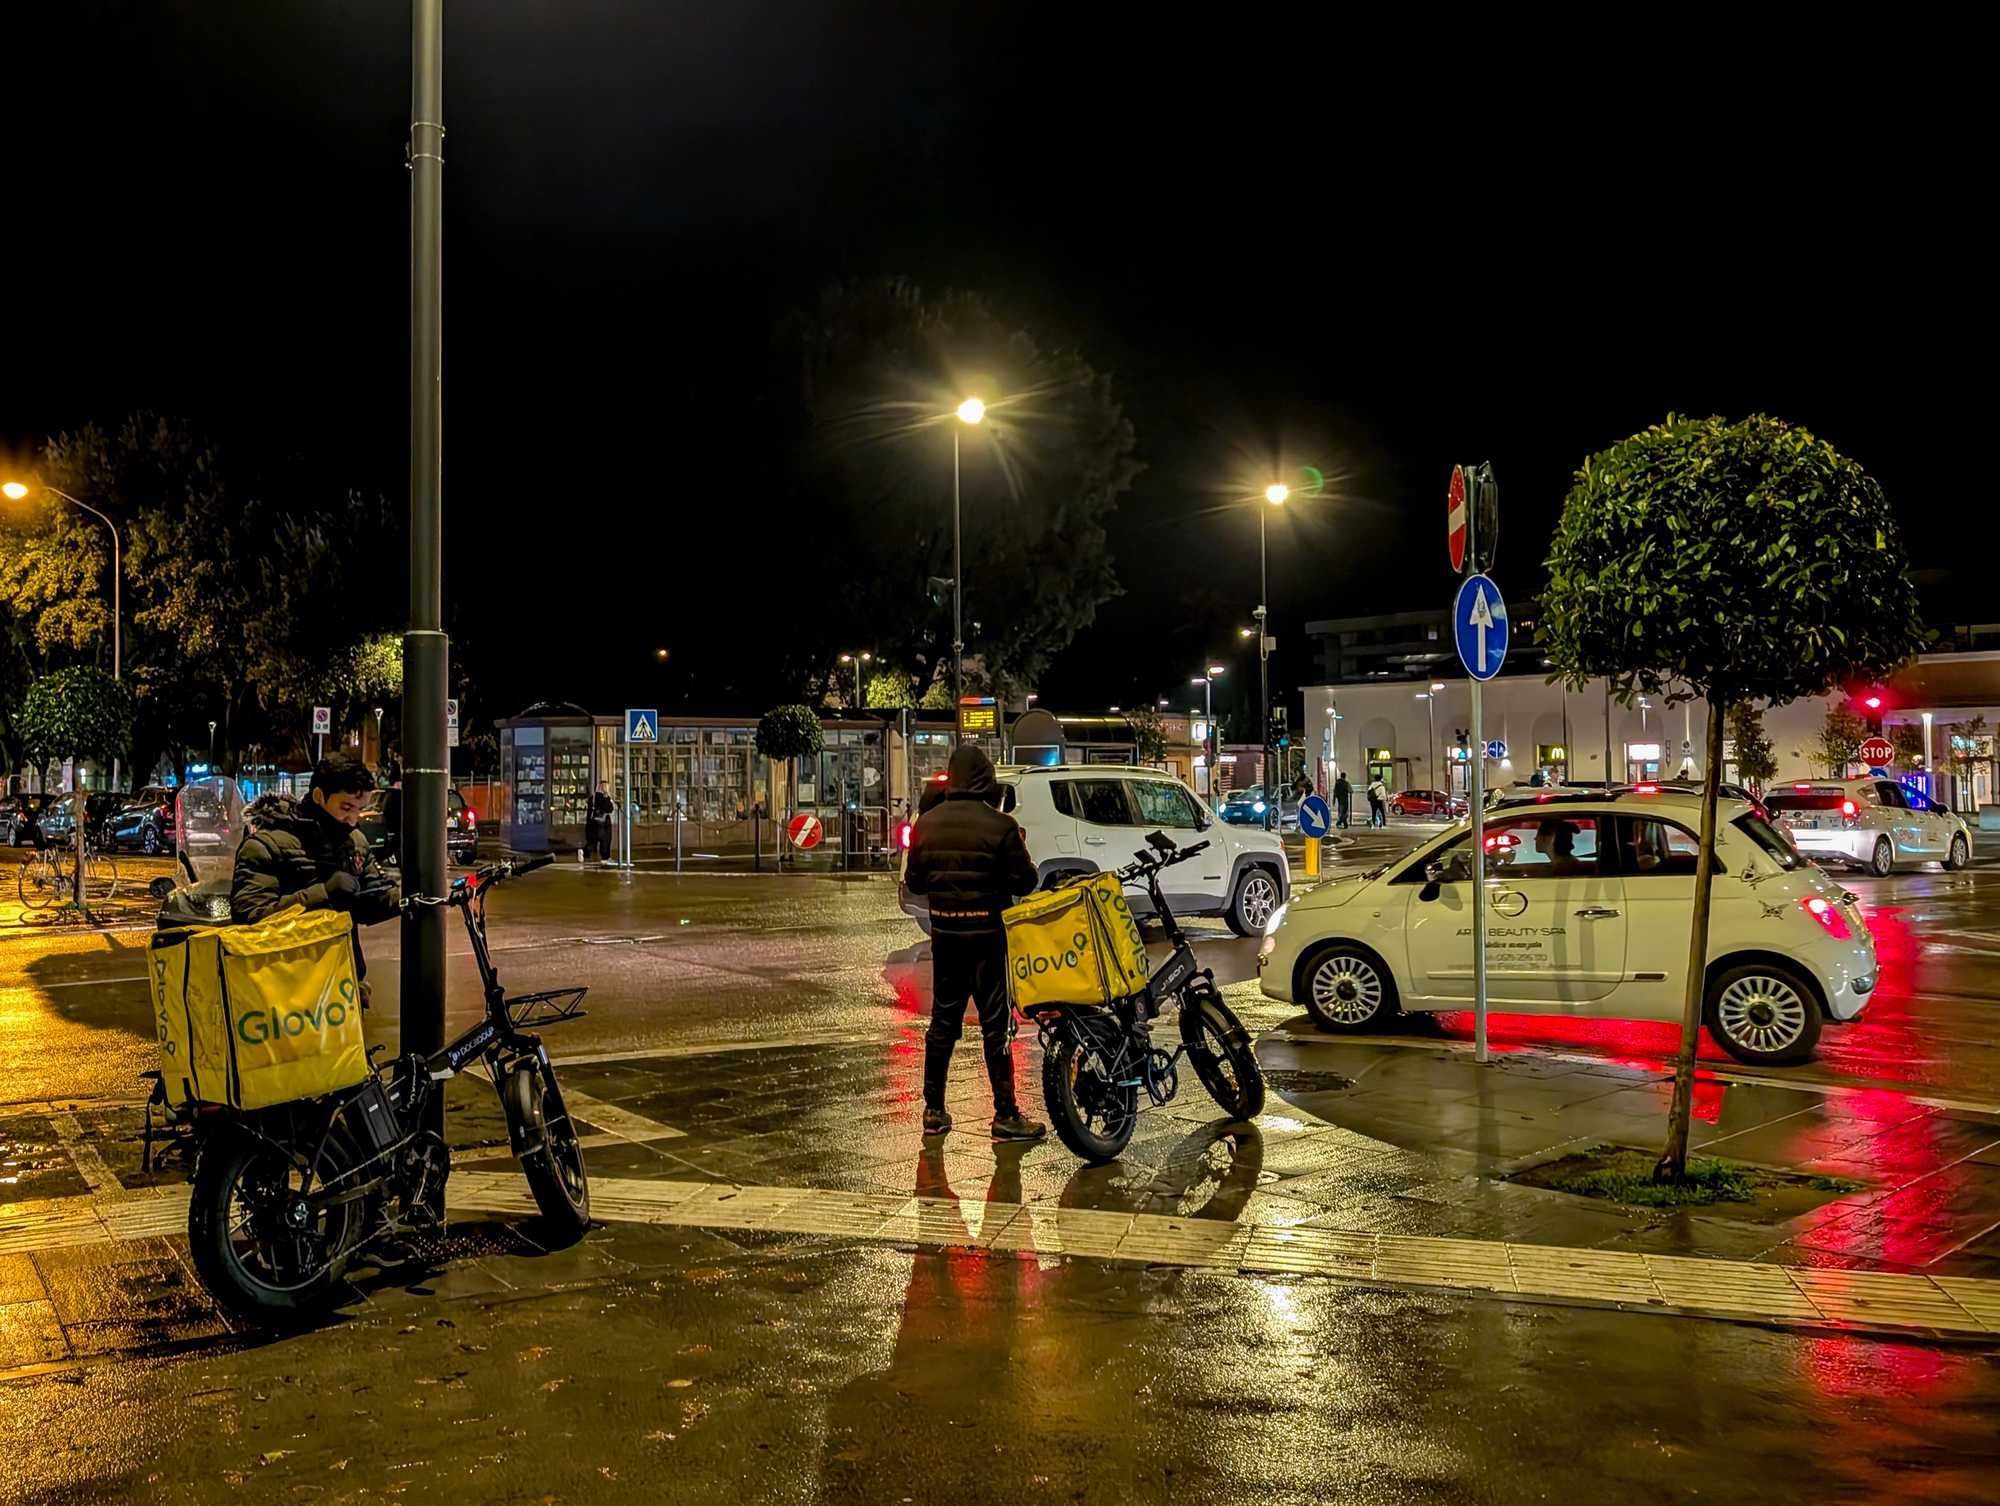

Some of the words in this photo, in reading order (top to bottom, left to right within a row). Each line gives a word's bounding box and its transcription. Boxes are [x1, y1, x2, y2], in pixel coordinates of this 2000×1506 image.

[1862, 746, 1892, 759] STOP
[1113, 895, 1148, 975] Glovo
[1455, 927, 1475, 937] AR
[1488, 927, 1539, 937] BEAUTY
[1540, 927, 1567, 937] SPA
[1014, 950, 1079, 980] Glovo
[237, 1002, 347, 1045] Glovo
